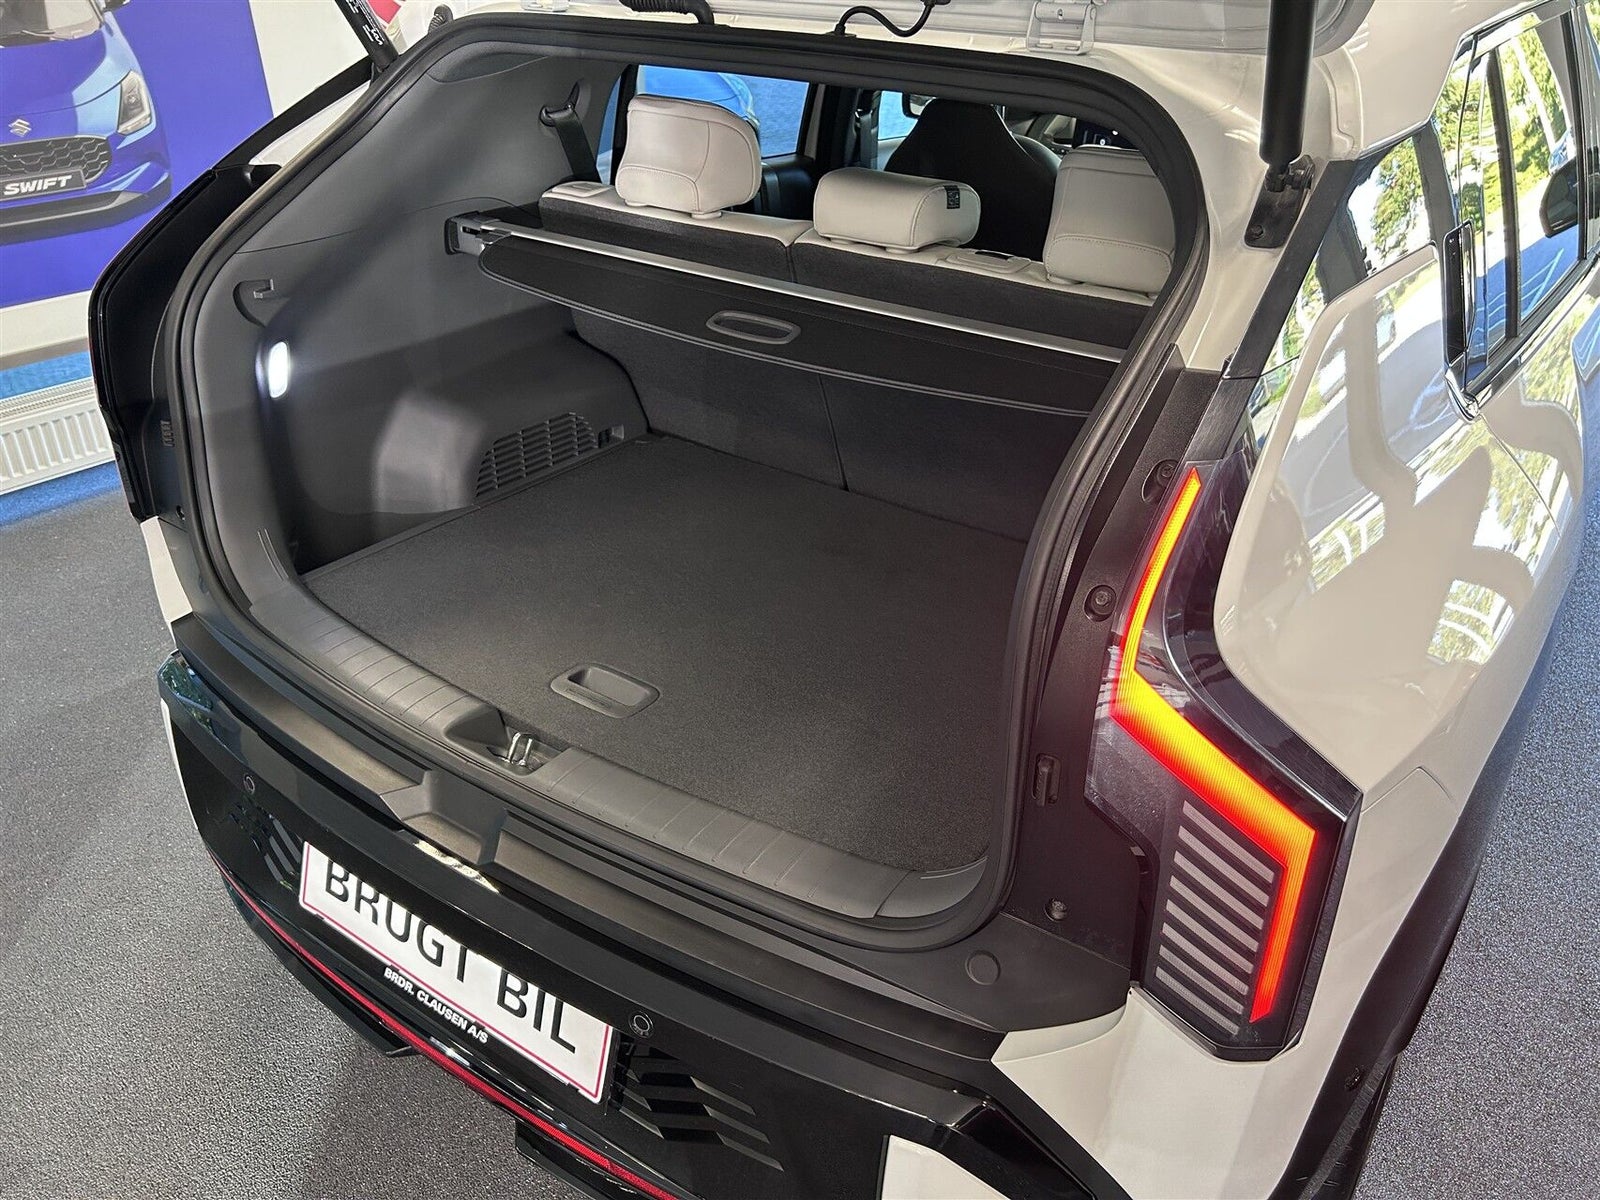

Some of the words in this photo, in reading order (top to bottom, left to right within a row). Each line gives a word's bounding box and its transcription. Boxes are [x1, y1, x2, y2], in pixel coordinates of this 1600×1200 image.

[3, 174, 73, 196] SWIFT
[383, 967, 415, 996] BRDR.
[416, 989, 468, 1031] CLAUSEN
[467, 1024, 489, 1045] A/S
[497, 967, 576, 1055] BIL
